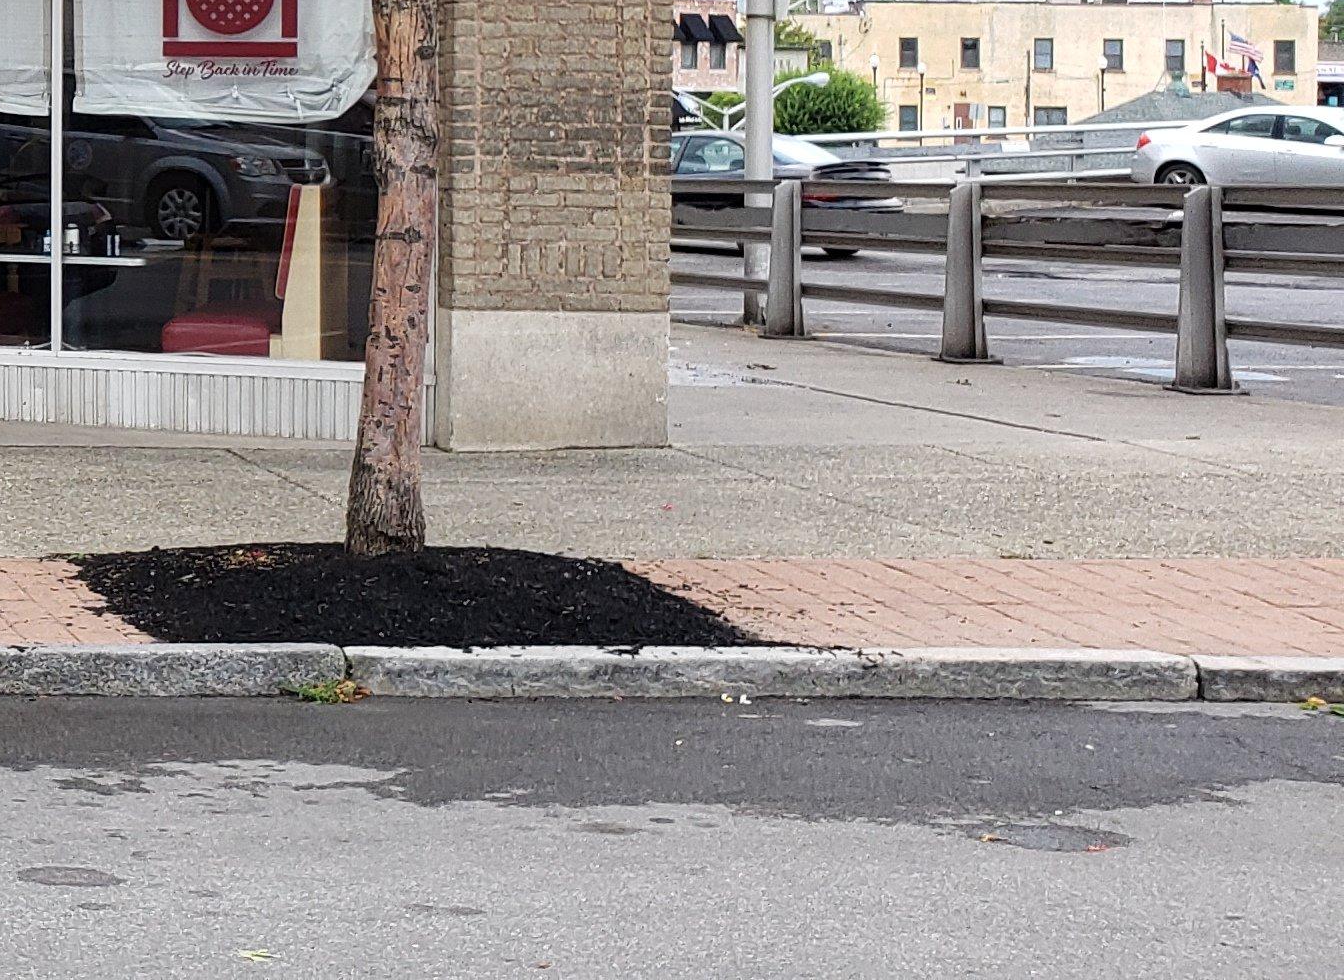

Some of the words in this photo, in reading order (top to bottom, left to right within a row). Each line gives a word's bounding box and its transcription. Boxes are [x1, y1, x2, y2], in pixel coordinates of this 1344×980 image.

[162, 60, 195, 79] Step
[197, 60, 240, 80] Back
[242, 63, 261, 76] in
[260, 59, 299, 77] Time
